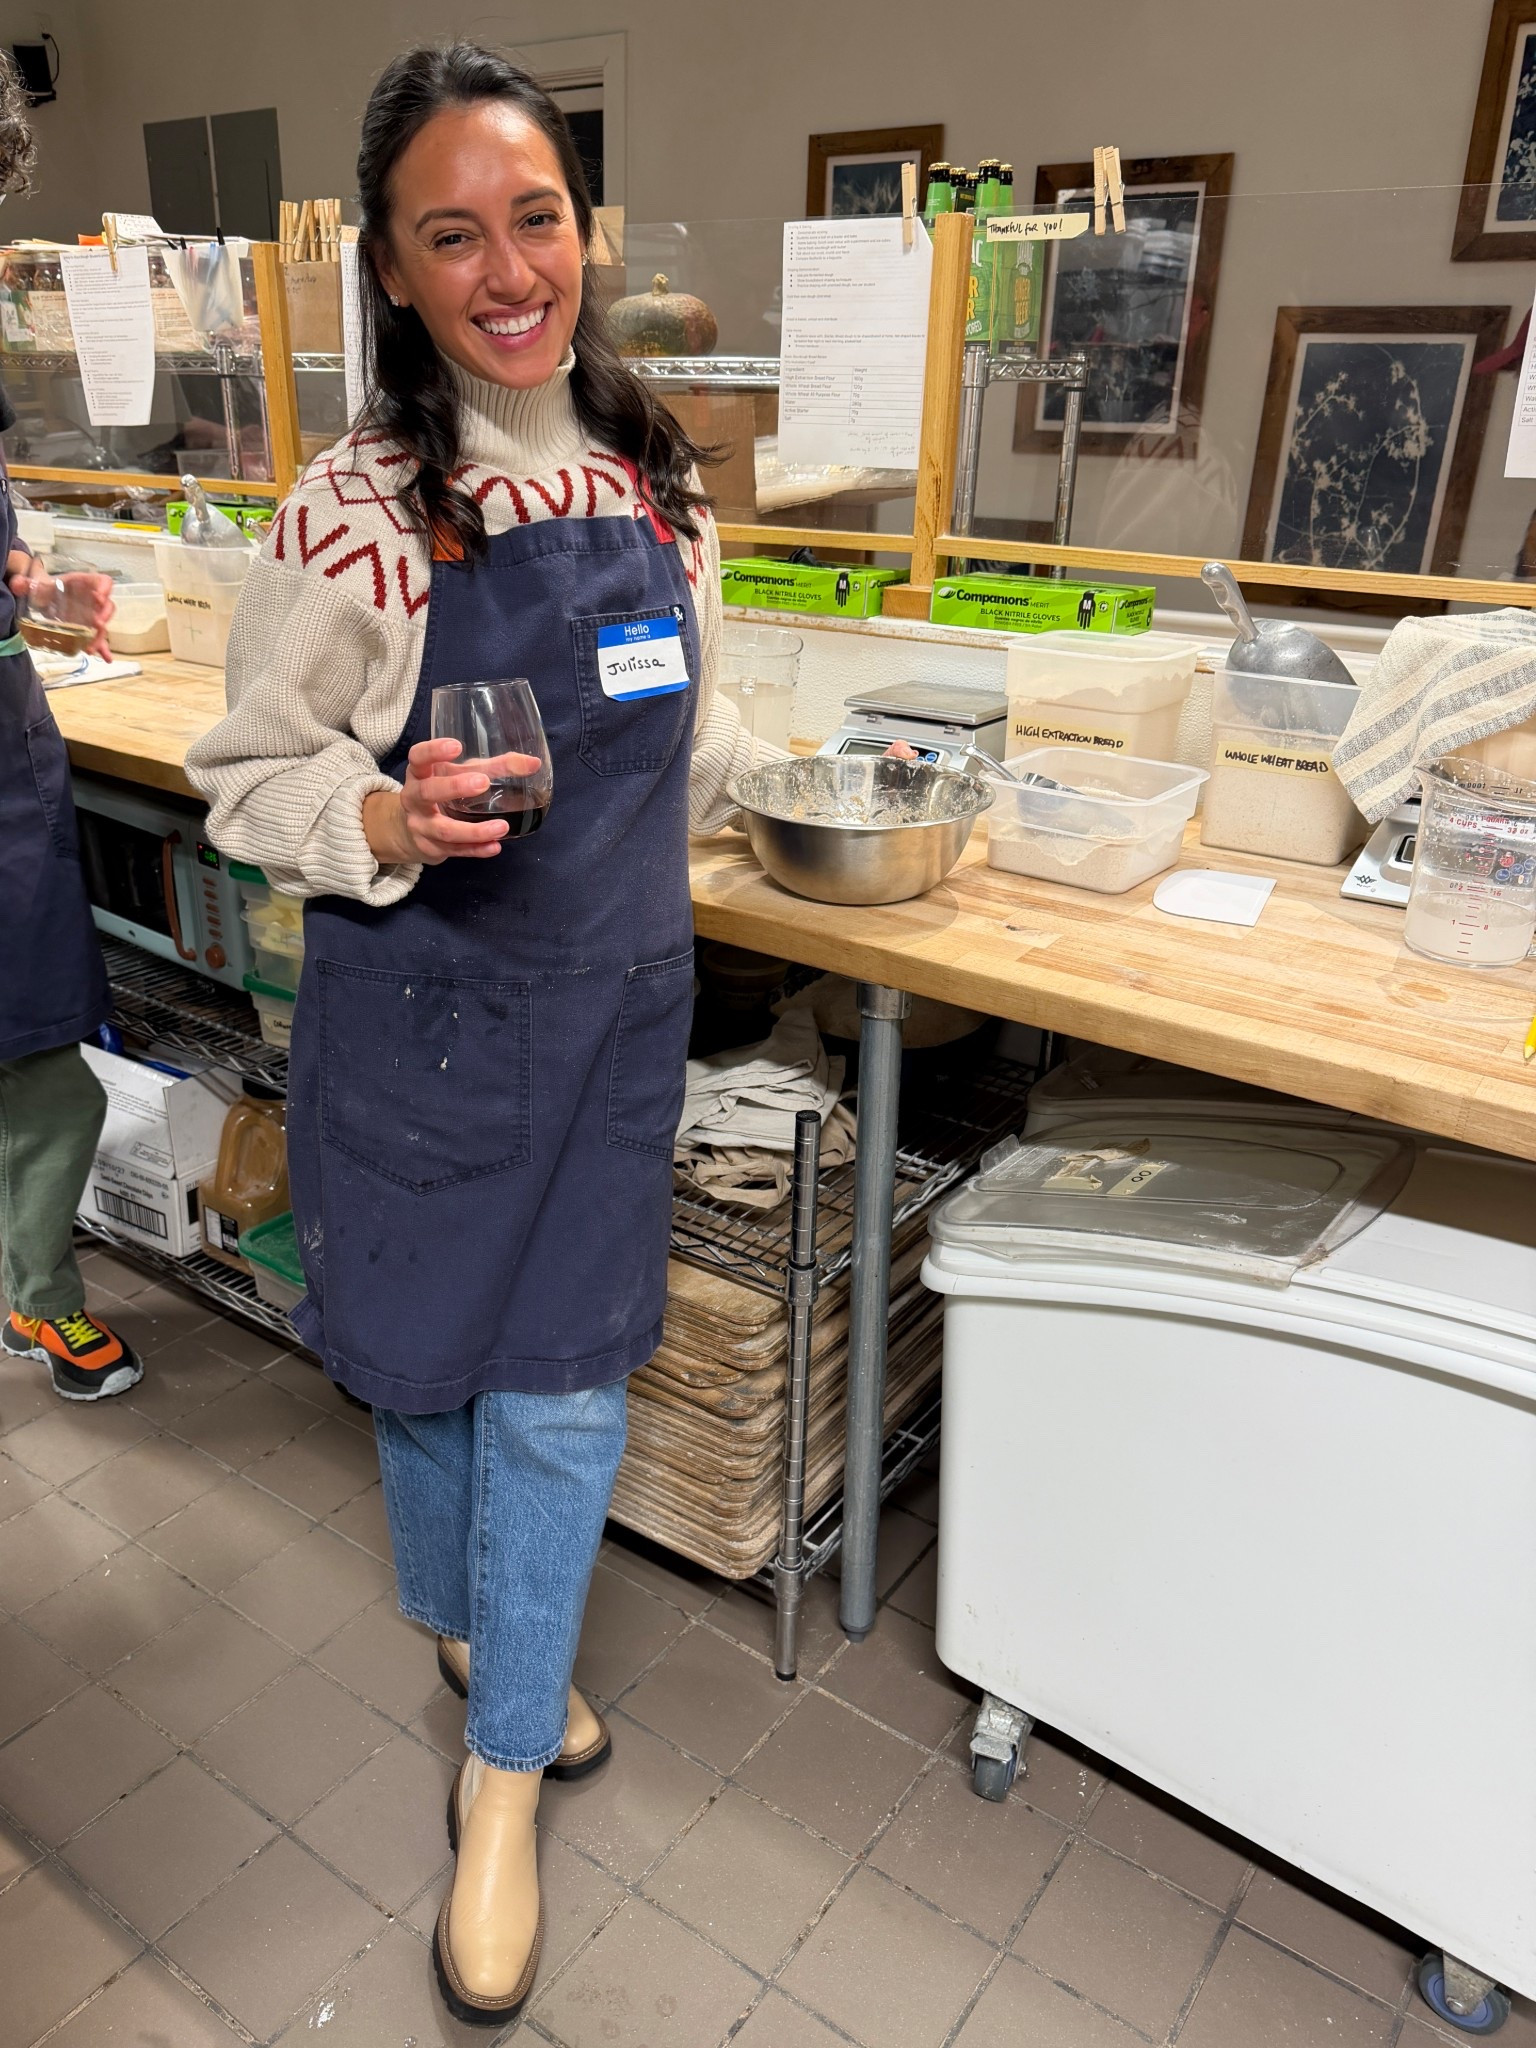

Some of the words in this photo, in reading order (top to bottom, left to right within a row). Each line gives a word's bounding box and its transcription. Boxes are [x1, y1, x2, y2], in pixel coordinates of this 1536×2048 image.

[734, 570, 796, 587] Companions
[839, 579, 847, 590] M
[754, 588, 774, 596] BLACK
[798, 593, 822, 601] GLOVES
[956, 589, 1030, 607] Companions
[1082, 599, 1092, 611] M
[980, 608, 1003, 616] BLACK
[1005, 610, 1031, 619] NITRILE
[1032, 613, 1061, 622] GLOVES
[624, 623, 650, 637] Hello
[606, 656, 666, 676] Julissa
[1015, 724, 1040, 739] HIGH
[1042, 728, 1092, 744] EXTRACTION
[1093, 735, 1124, 749] BREAD
[1224, 749, 1260, 765] WHOLE
[1261, 752, 1295, 769] WHEAT
[1295, 759, 1329, 773] BREAD
[1456, 818, 1478, 829] CUPS
